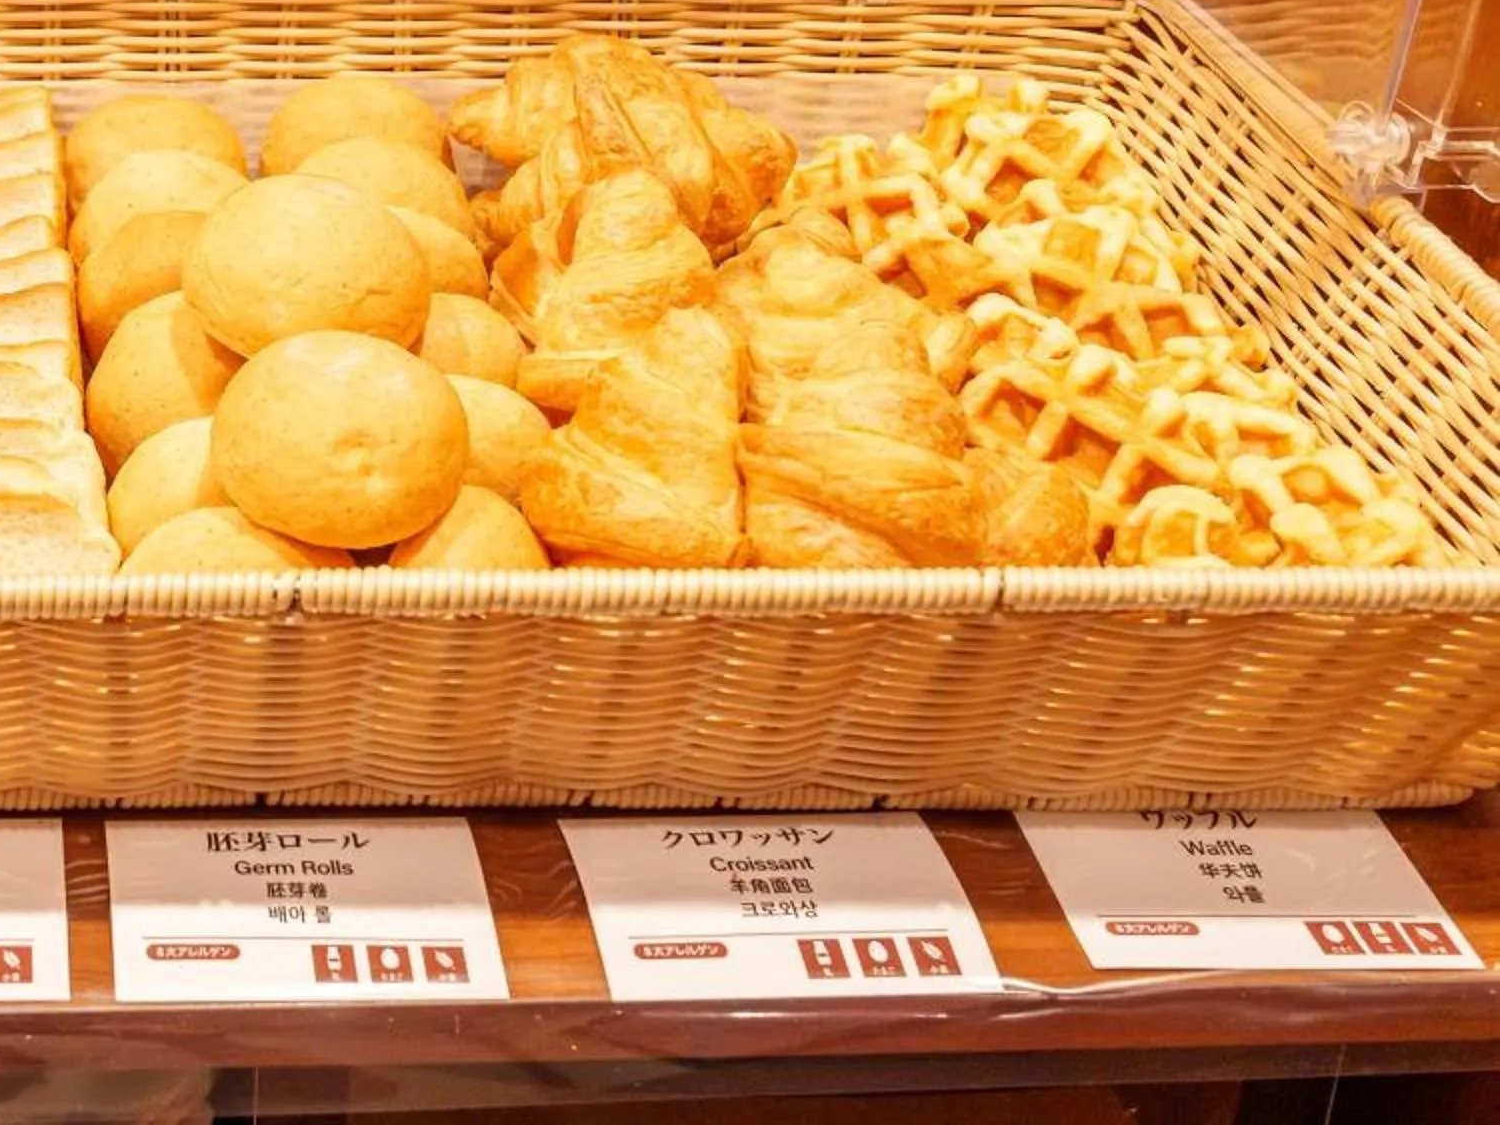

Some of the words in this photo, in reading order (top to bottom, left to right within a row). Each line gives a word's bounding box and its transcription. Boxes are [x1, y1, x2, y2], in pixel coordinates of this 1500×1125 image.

[206, 831, 371, 852] 胚芽ロール
[661, 826, 835, 850] クロワッサン
[1178, 840, 1254, 856] Waffle
[234, 860, 295, 876] Germ
[301, 859, 355, 876] Rolls
[709, 856, 815, 872] Croissant
[729, 875, 814, 894] 羊角面包
